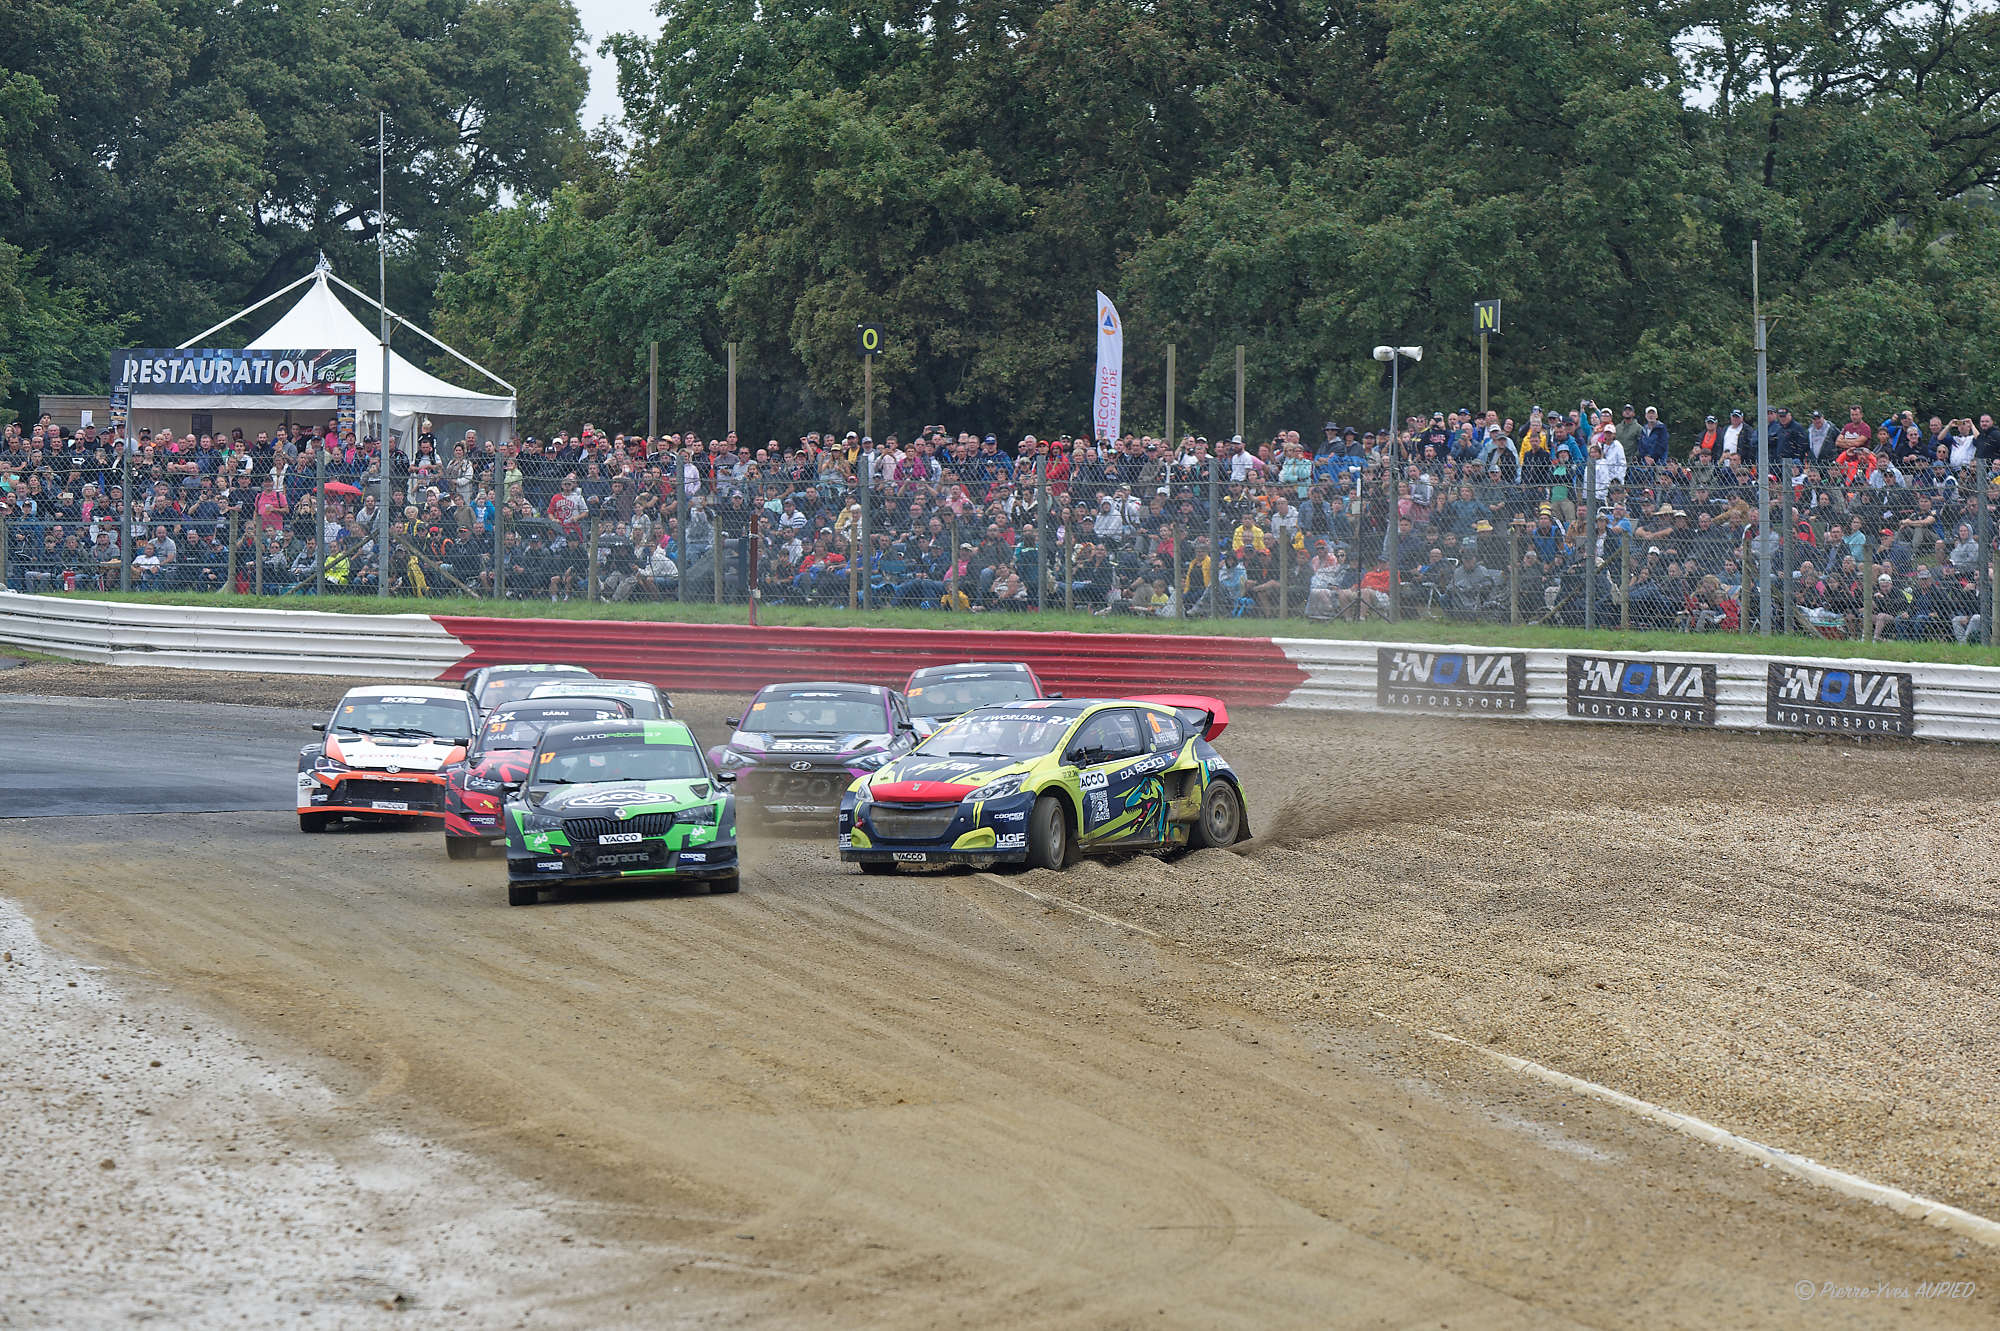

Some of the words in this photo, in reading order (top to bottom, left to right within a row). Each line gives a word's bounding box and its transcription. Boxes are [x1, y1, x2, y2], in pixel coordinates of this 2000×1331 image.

[1480, 305, 1493, 329] N
[122, 358, 316, 385] RESTAURATION
[1387, 693, 1516, 710] MOTORSPORT
[1577, 702, 1705, 722] MOTORSPORT
[1777, 710, 1903, 733] MOTORSPORT
[540, 752, 556, 764] 17
[604, 834, 638, 844] YACCO
[996, 832, 1025, 843] UGF
[896, 853, 923, 861] YACCO
